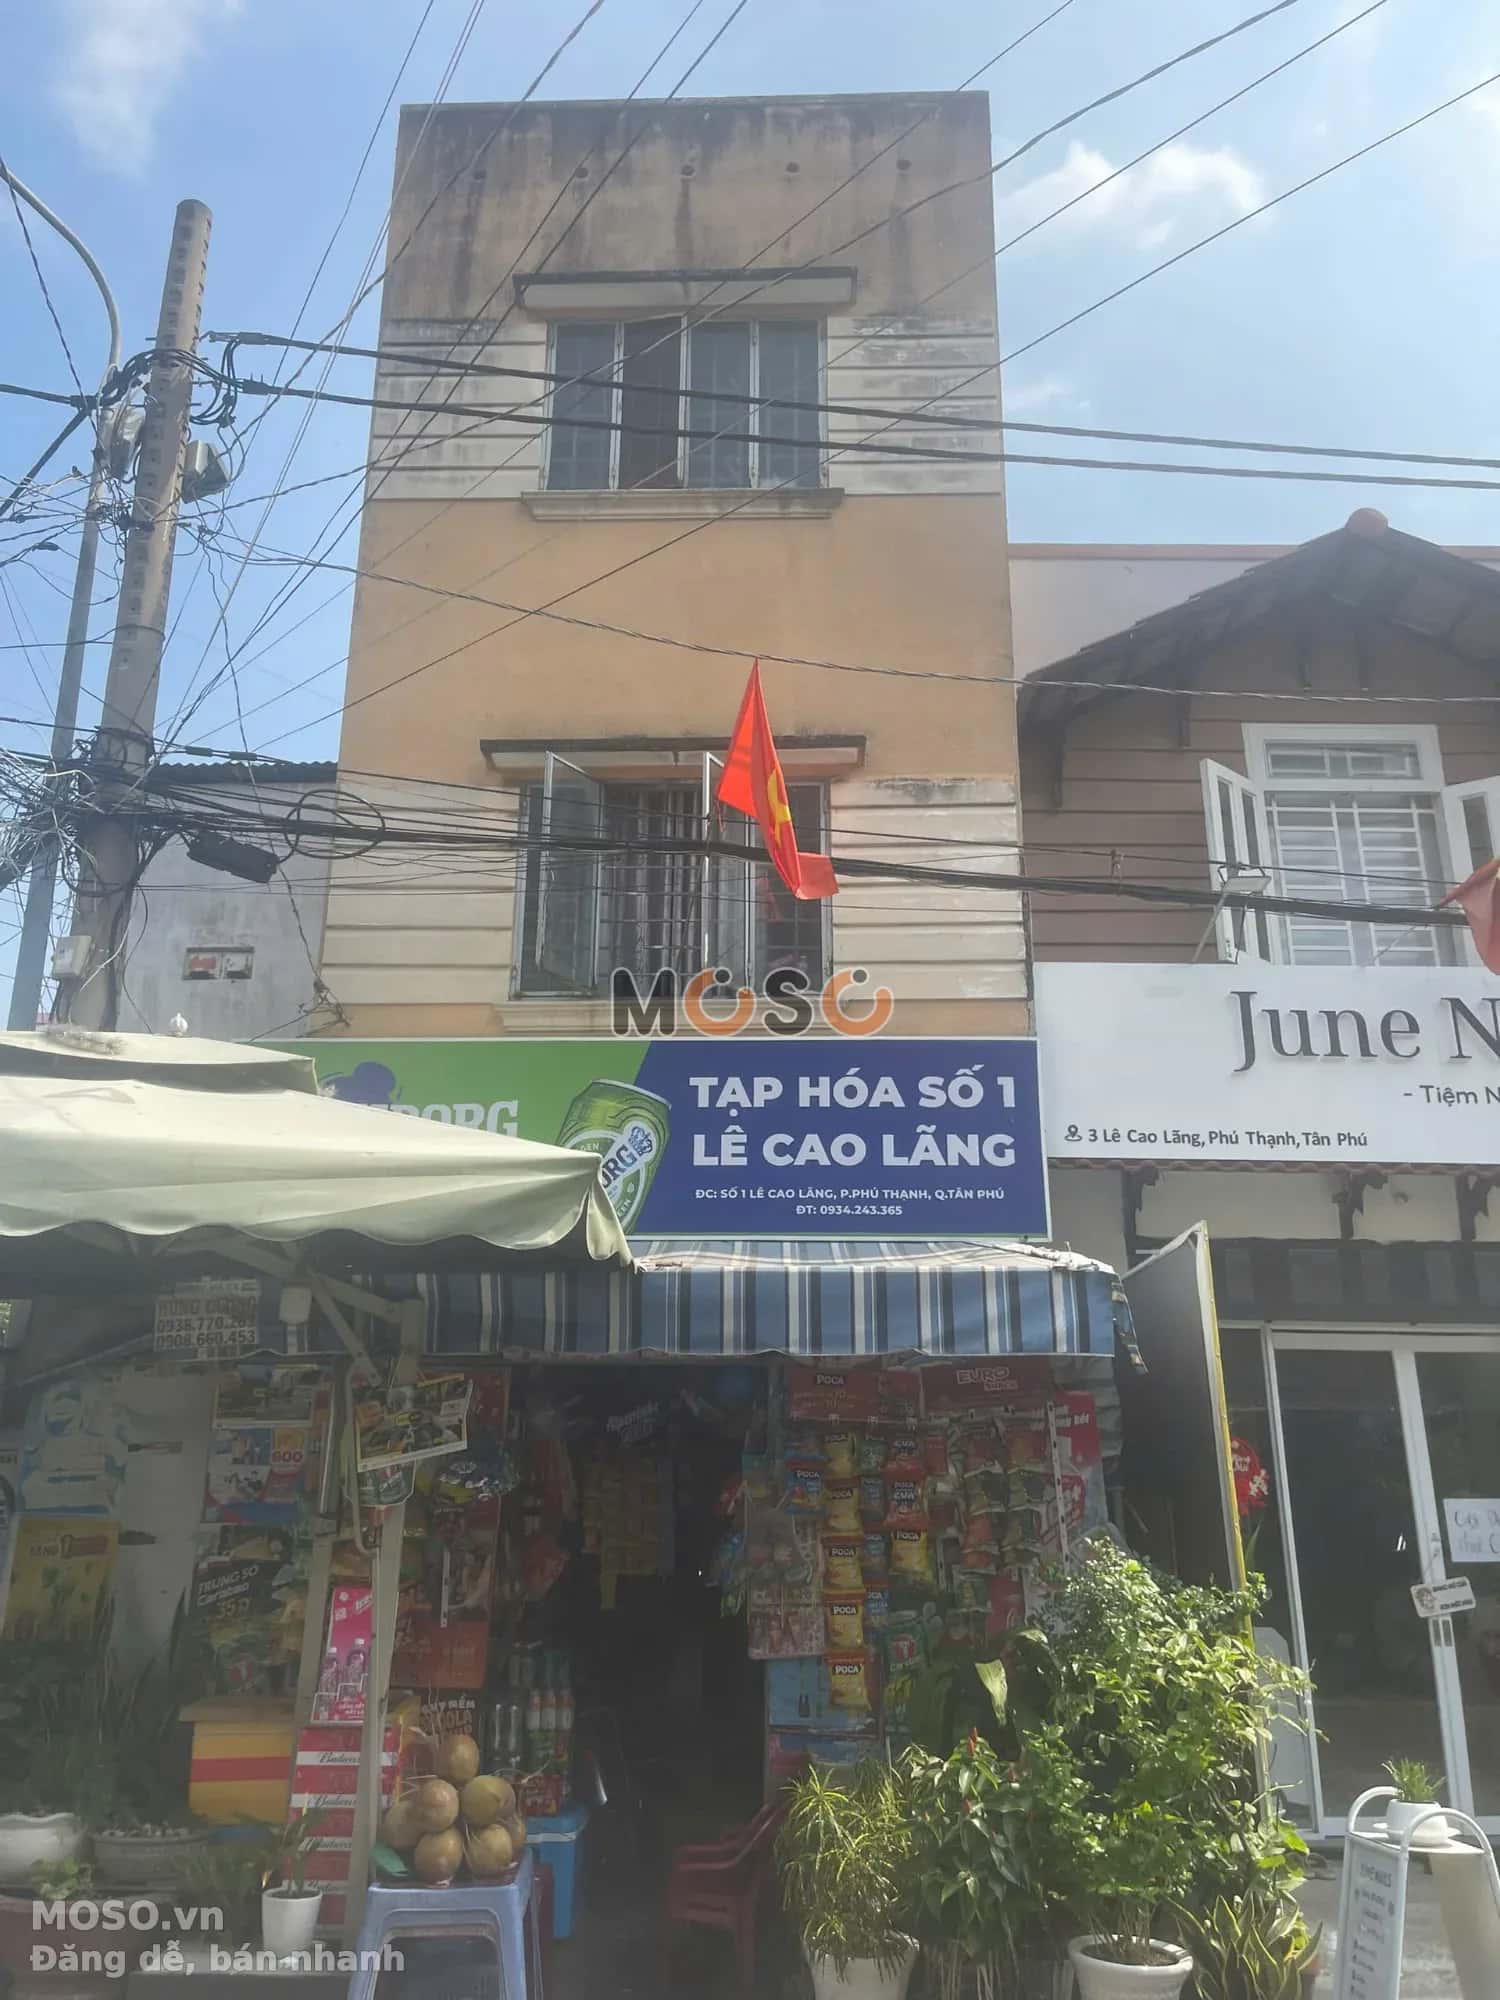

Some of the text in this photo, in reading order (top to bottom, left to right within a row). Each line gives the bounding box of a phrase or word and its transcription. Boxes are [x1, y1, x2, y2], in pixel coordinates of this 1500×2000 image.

[1230, 991, 1421, 1072] June
[689, 1064, 1016, 1117] TẠP HÓA SỐ 1
[1419, 1085, 1478, 1105] Tiệm
[1088, 1130, 1098, 1142] 3
[1103, 1127, 1120, 1143] Lê
[1127, 1131, 1158, 1144] Cao
[1209, 1129, 1239, 1145] Phú
[1337, 1131, 1368, 1147] Phú
[693, 1124, 1016, 1167] LÊ CAO LÃNG
[696, 1189, 717, 1199] ĐC:
[721, 1186, 738, 1199] SỐ
[741, 1189, 747, 1199] 1
[750, 1186, 765, 1199] LÊ
[768, 1189, 795, 1199] CAO
[840, 1186, 879, 1199] P.PHÚ
[883, 1189, 931, 1201] THẠNH,
[935, 1187, 973, 1200] Q.TÂN
[977, 1187, 1005, 1199] PHÚ
[796, 1205, 903, 1216] ĐT: 0934.243.365
[816, 1374, 845, 1385] POCA
[957, 1367, 1010, 1385] EURO
[831, 1547, 855, 1557] POCA
[833, 1605, 857, 1615] POCA
[835, 1664, 859, 1674] POCA
